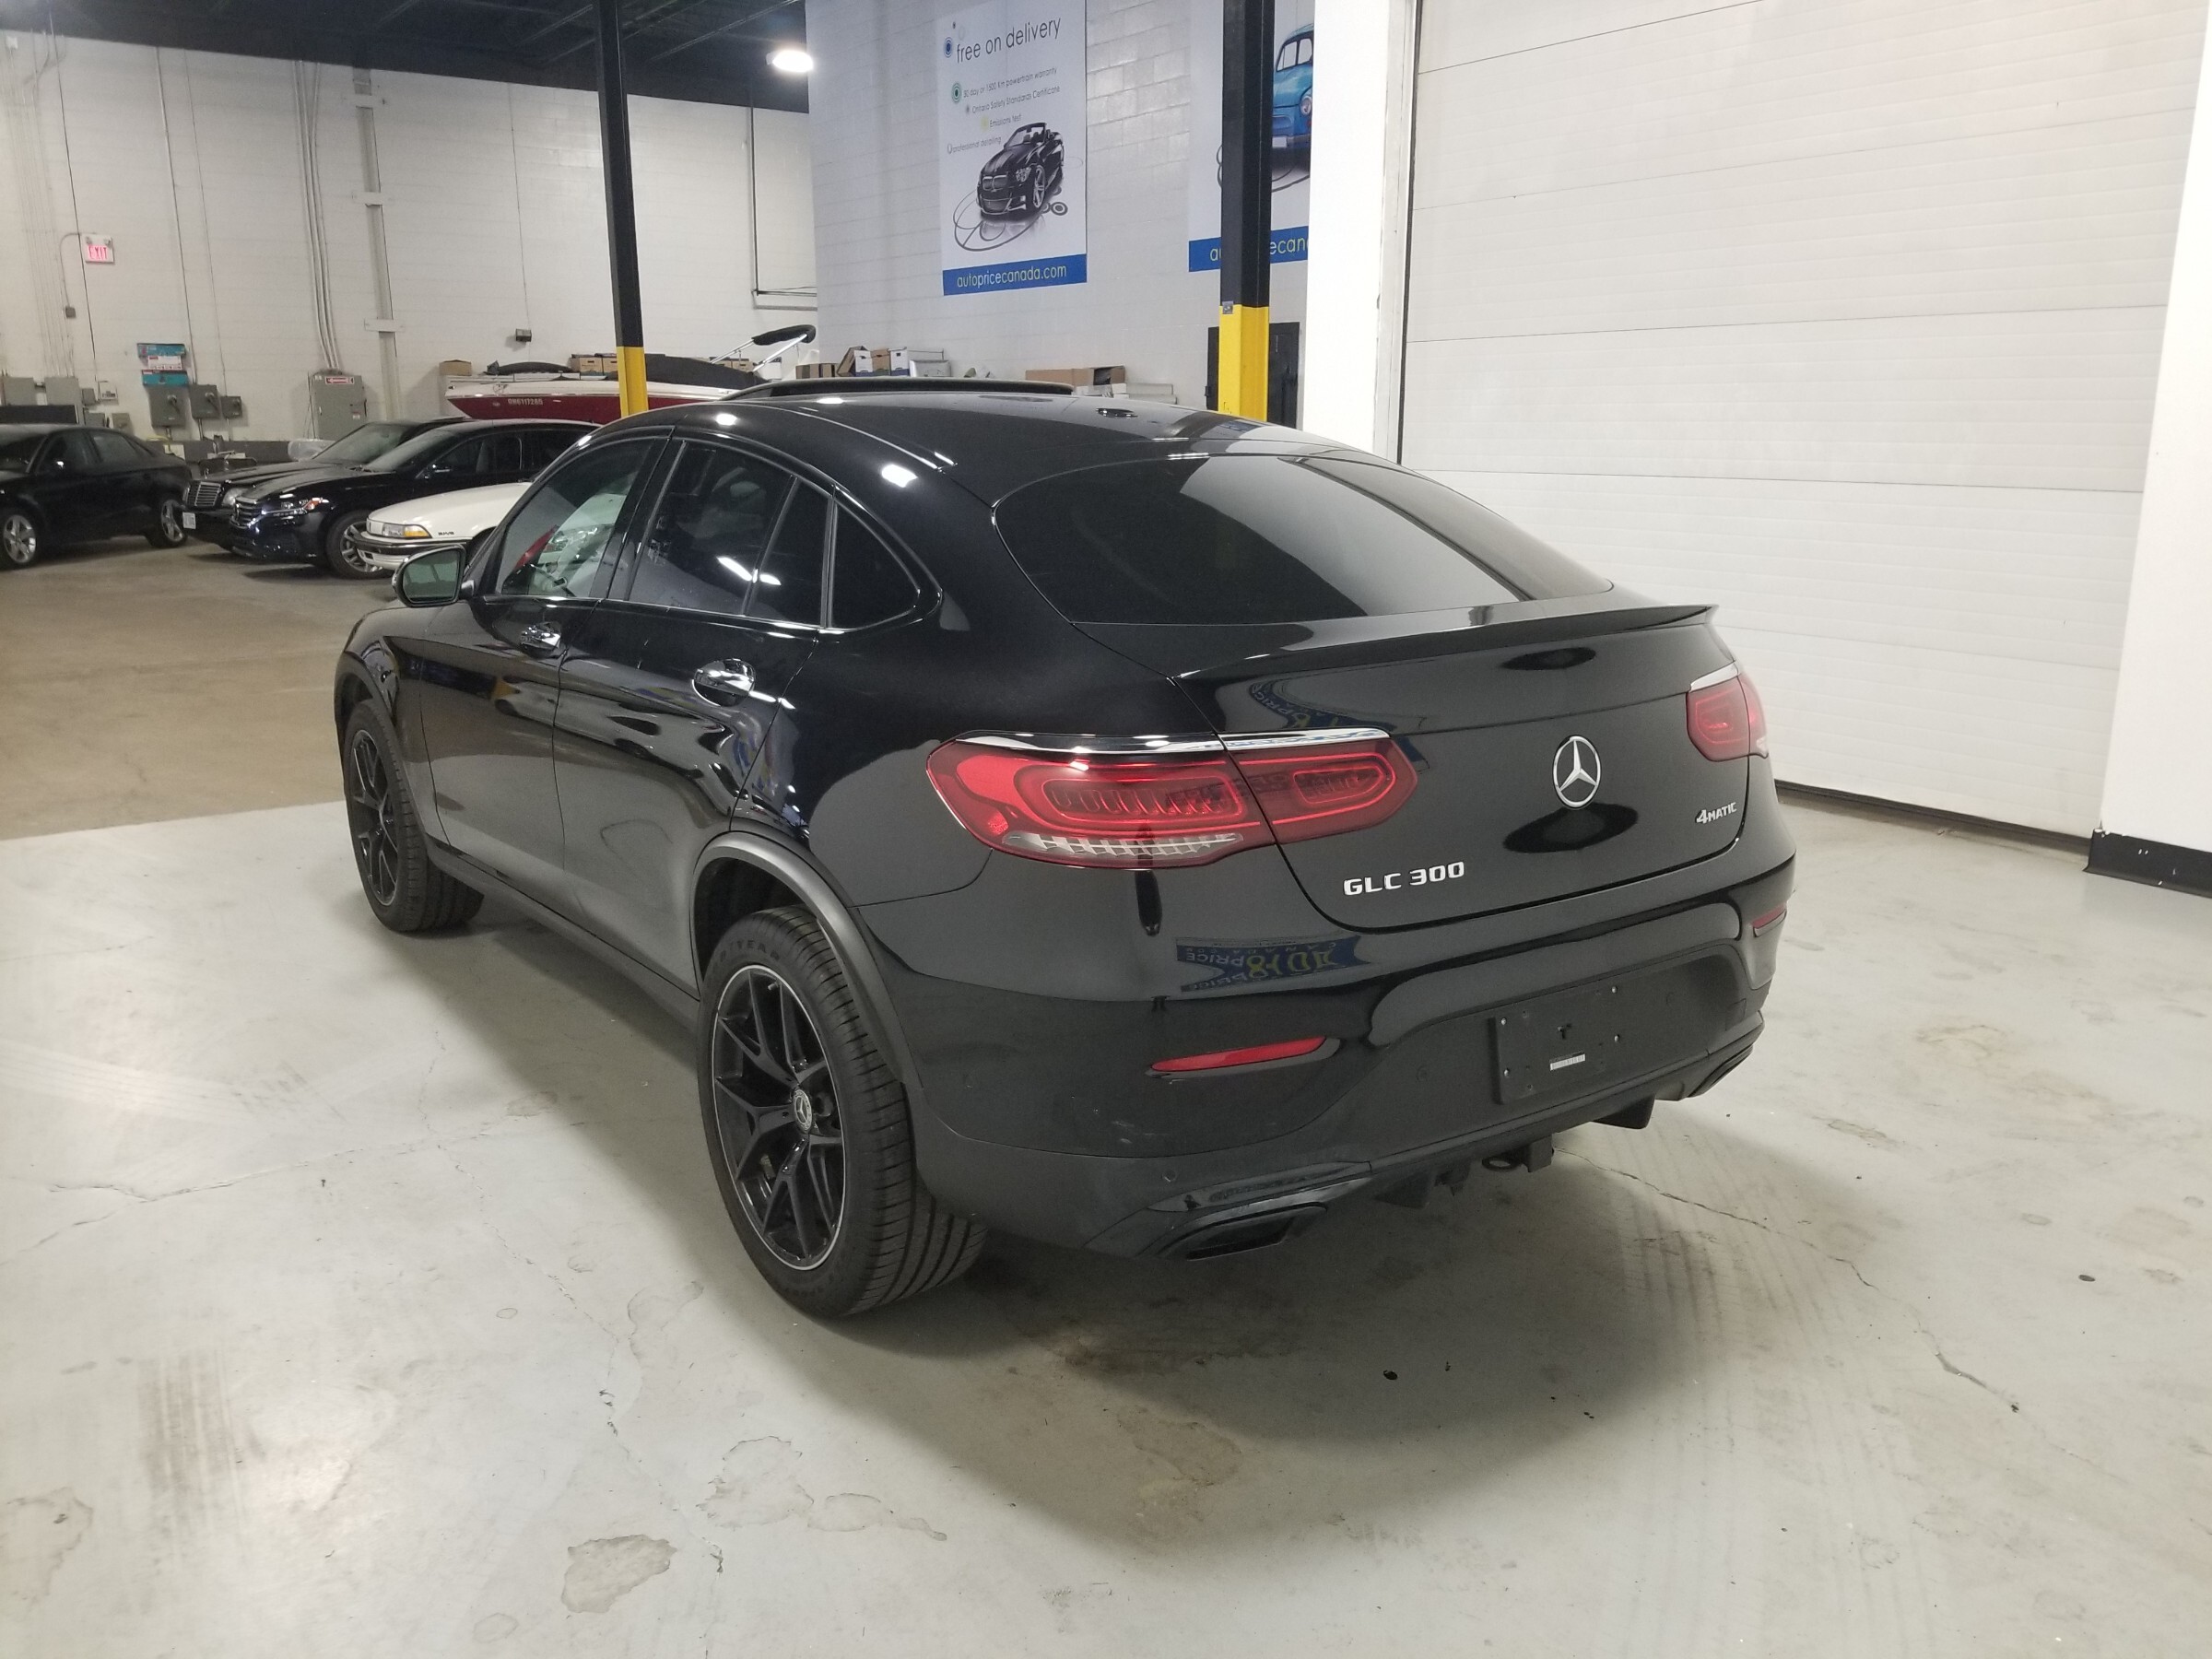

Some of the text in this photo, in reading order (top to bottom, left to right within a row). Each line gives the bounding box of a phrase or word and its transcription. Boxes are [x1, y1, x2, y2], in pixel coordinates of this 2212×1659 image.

[957, 18, 1061, 64] free on delivery
[1006, 74, 1033, 88] powertrain
[1034, 66, 1057, 79] warranty
[972, 86, 1060, 113] Ontario Safety Standards Certificate
[88, 244, 108, 260] EXIT
[957, 265, 1067, 288] autopricecanada.com
[1696, 802, 1737, 824] 4MATIC
[1343, 861, 1465, 896] GLC 300
